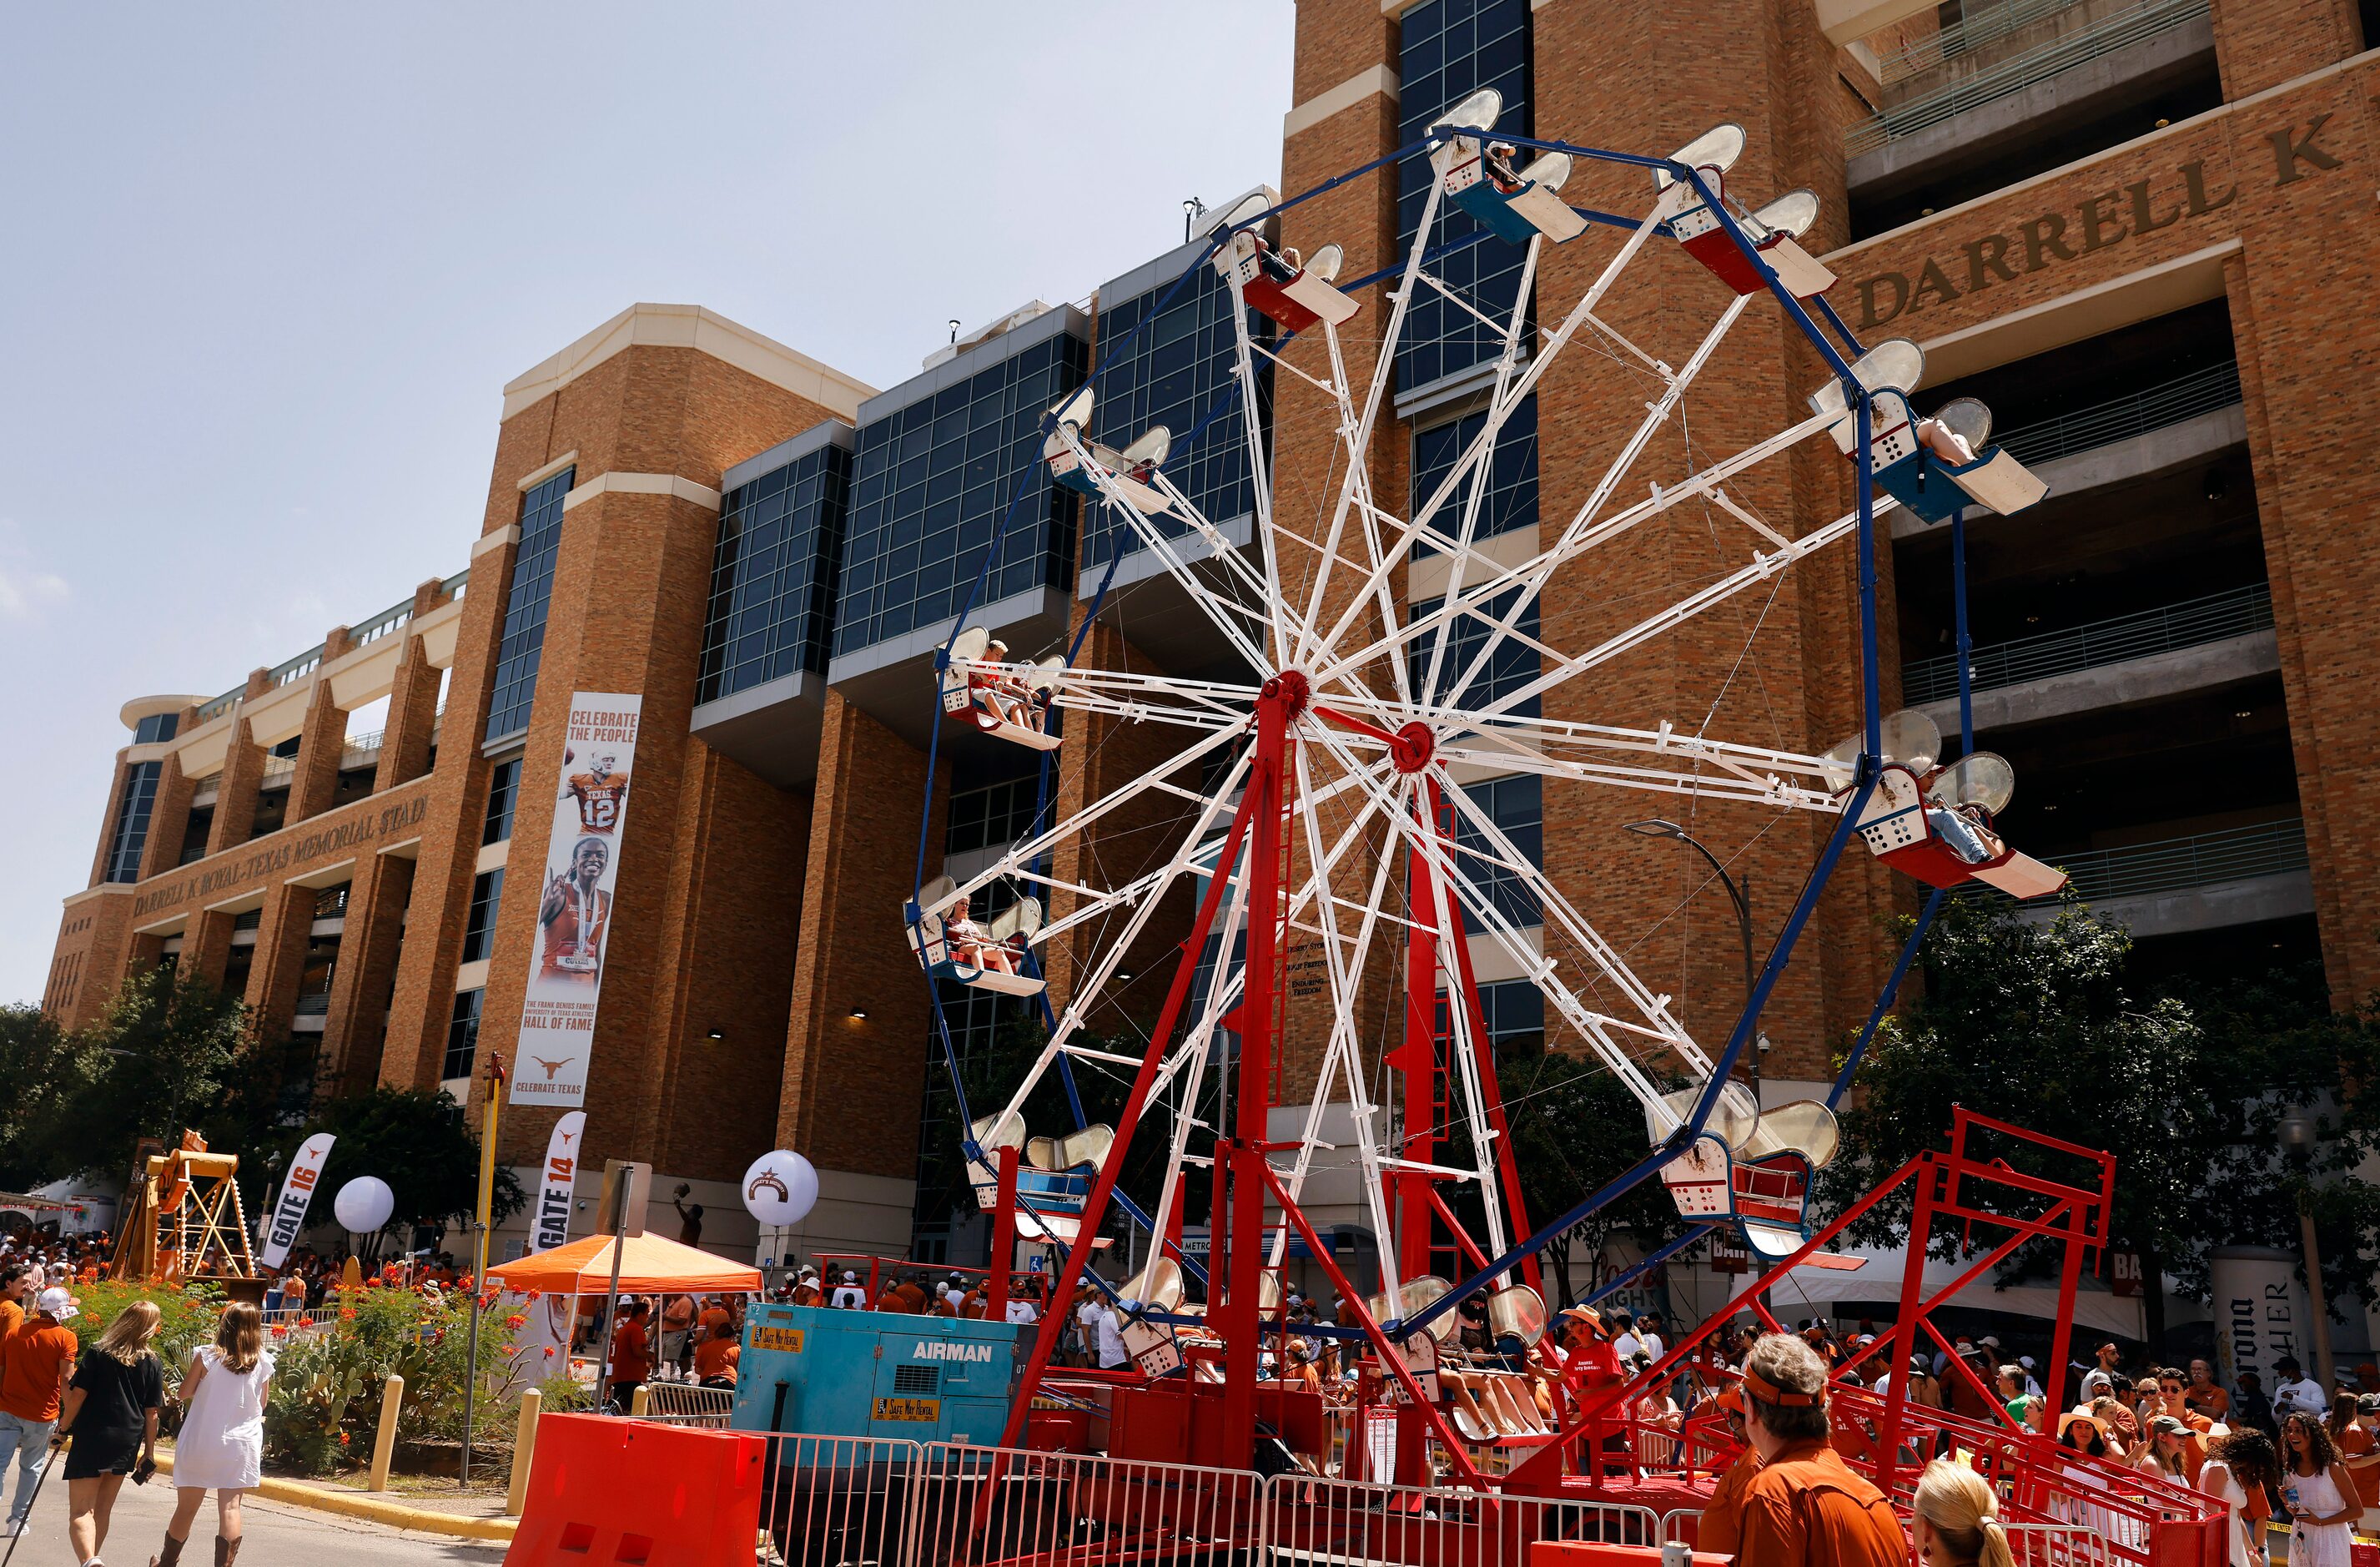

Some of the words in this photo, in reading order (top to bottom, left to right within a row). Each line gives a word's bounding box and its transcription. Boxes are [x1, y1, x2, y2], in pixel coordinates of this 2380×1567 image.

[1854, 159, 2237, 330] DARRELL
[2266, 112, 2345, 187] K
[571, 710, 638, 728] CELEBRATE
[569, 727, 590, 741] THE
[593, 728, 636, 743] PEOPLE
[586, 790, 611, 799] TEXAS
[584, 799, 615, 828] 12
[133, 880, 184, 918] DARRELL
[186, 878, 200, 900] K
[293, 814, 375, 864] MEMORIAL
[1291, 978, 1324, 989] ENDURING
[524, 1016, 547, 1029] HALL
[551, 1017, 563, 1030] OF
[566, 1018, 592, 1031] FAME
[516, 1082, 556, 1094] CELEBRATE
[558, 1084, 581, 1095] TEXAS
[289, 1166, 318, 1192] 16
[548, 1156, 574, 1183] 14
[271, 1193, 308, 1248] GATE
[538, 1188, 570, 1249] GATE
[2113, 1252, 2142, 1281] BA
[913, 1341, 993, 1363] AIRMAN
[1692, 1355, 1701, 1363] 28
[2267, 1521, 2276, 1530] NOT
[2277, 1523, 2292, 1533] ENTER
